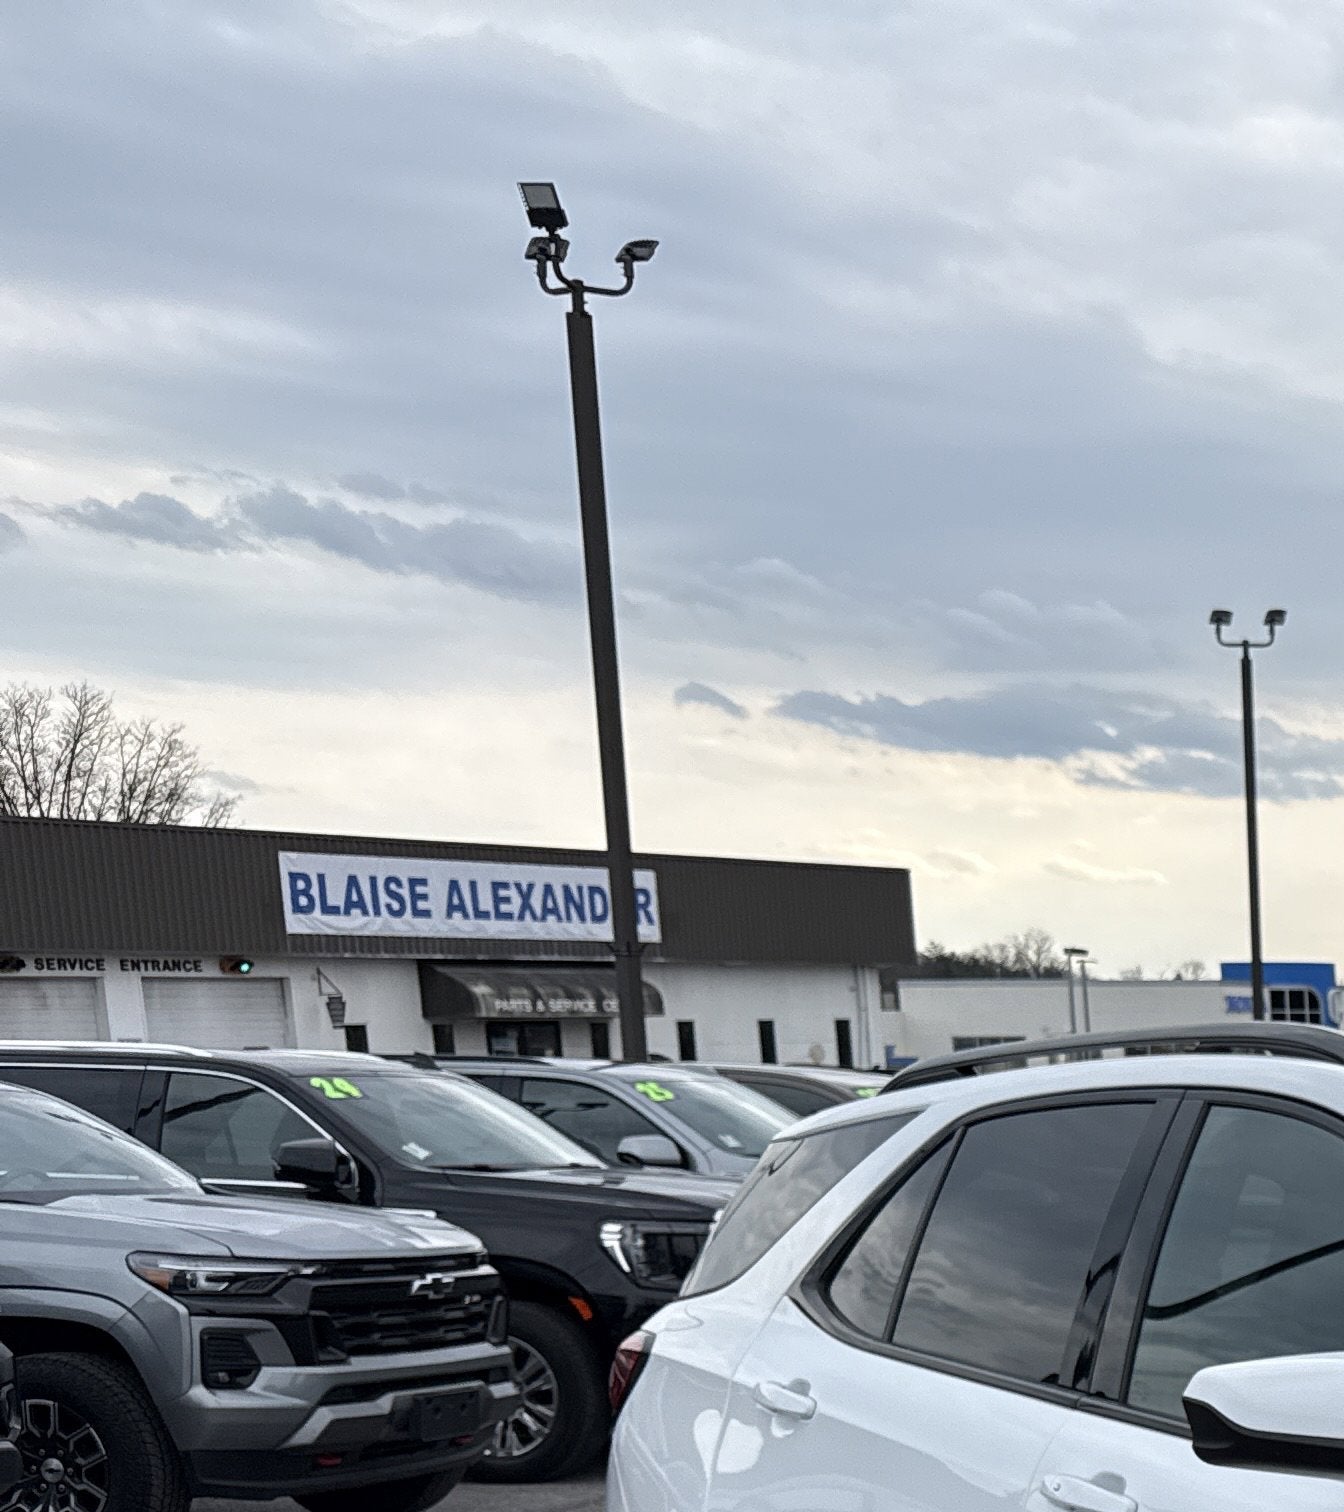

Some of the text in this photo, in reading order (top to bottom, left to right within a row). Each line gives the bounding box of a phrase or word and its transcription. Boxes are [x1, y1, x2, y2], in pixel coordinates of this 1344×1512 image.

[288, 871, 654, 927] BLAISE ALEXANDR
[34, 957, 202, 972] SERVICE ENTRANCE
[310, 1077, 362, 1099] 24
